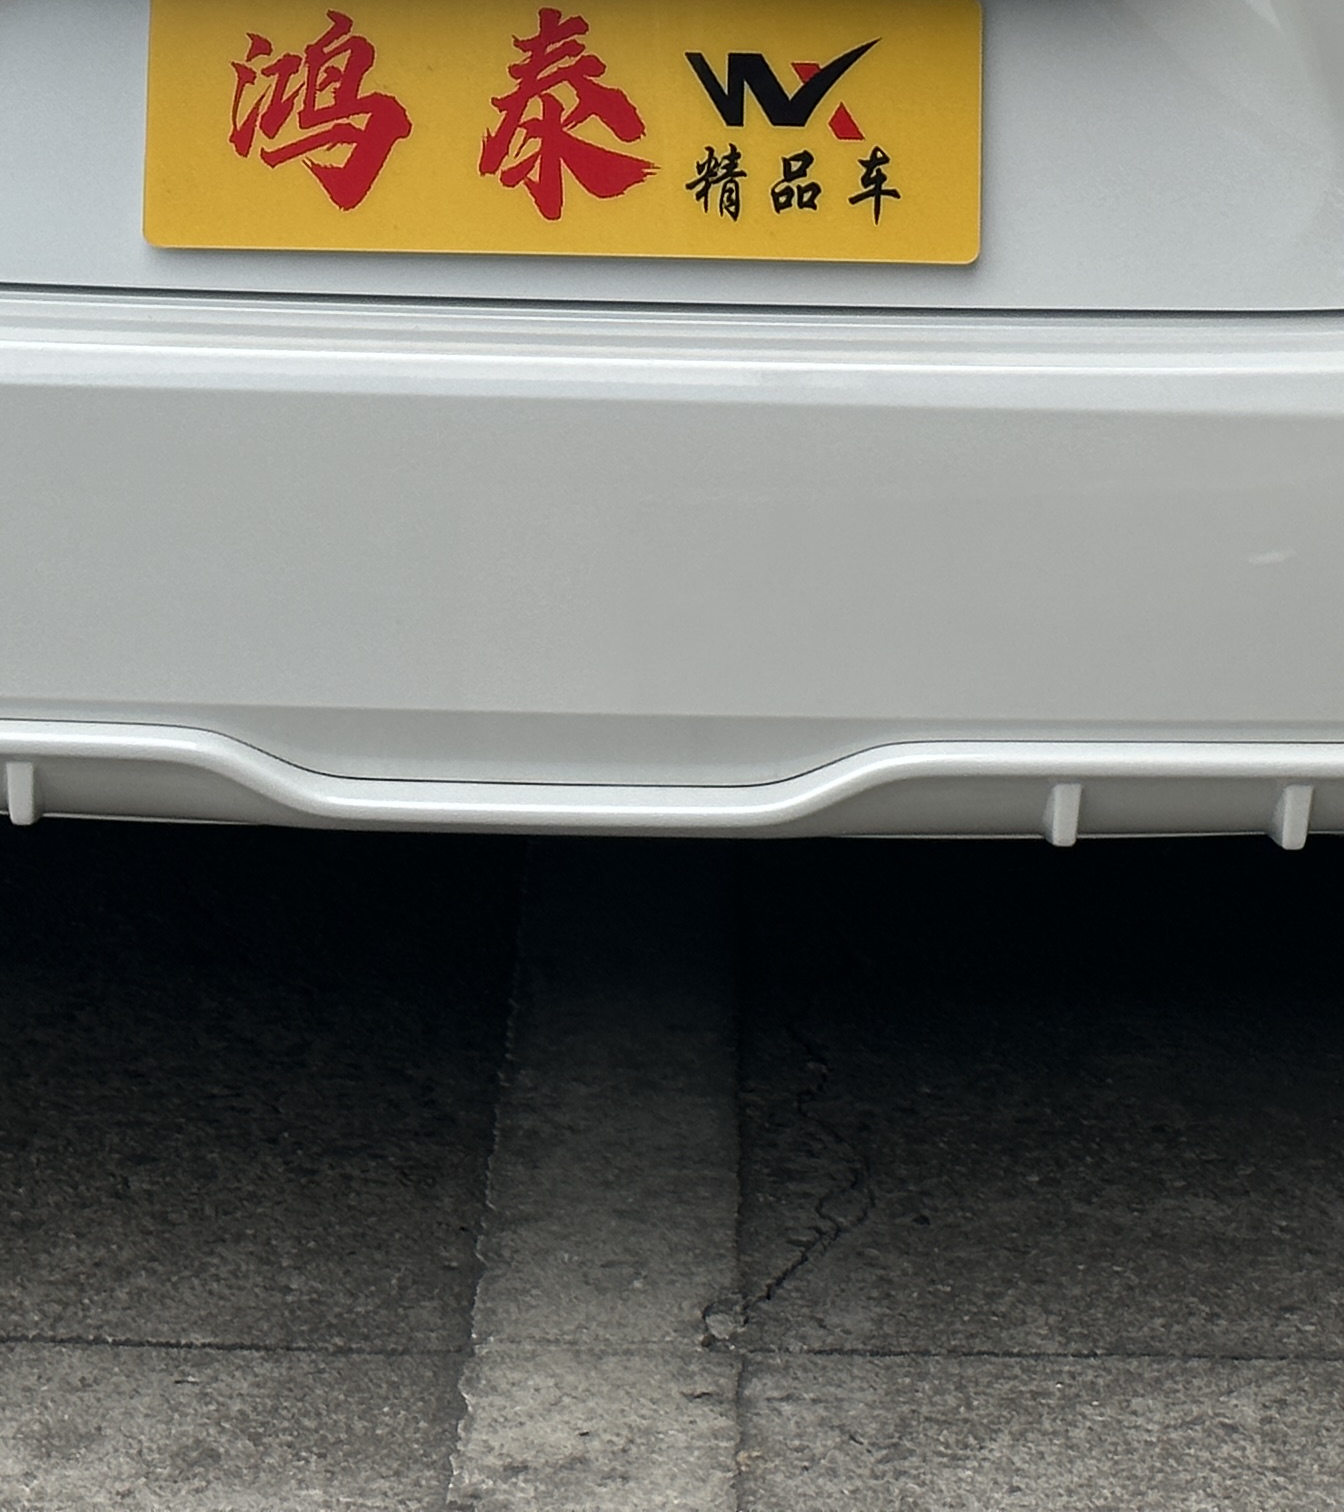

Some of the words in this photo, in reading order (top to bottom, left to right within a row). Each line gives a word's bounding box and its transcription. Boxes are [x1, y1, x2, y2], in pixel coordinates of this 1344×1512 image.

[227, 5, 662, 221] 鸿泰
[685, 144, 903, 226] 精品车
